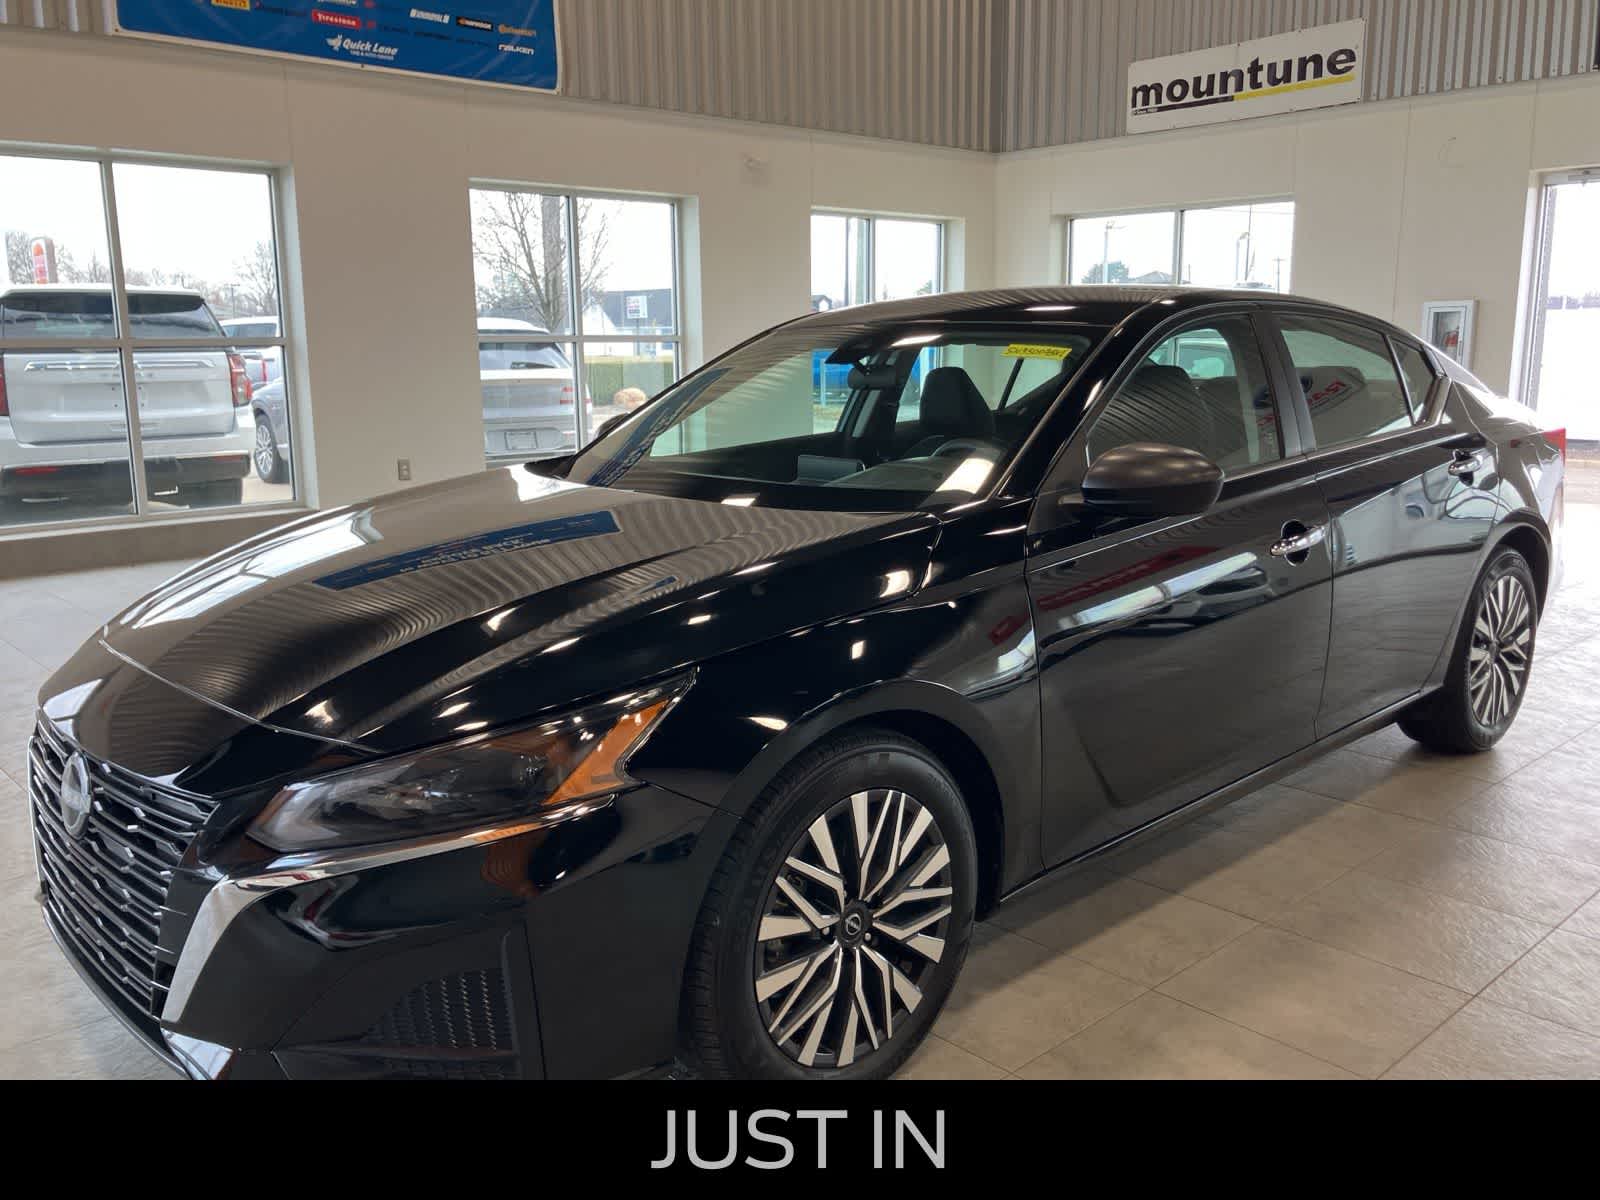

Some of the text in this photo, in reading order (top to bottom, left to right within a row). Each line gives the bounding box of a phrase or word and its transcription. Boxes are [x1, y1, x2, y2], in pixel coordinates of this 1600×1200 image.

[342, 38, 371, 51] Quick
[373, 43, 398, 56] Lane
[1131, 48, 1356, 108] mountune
